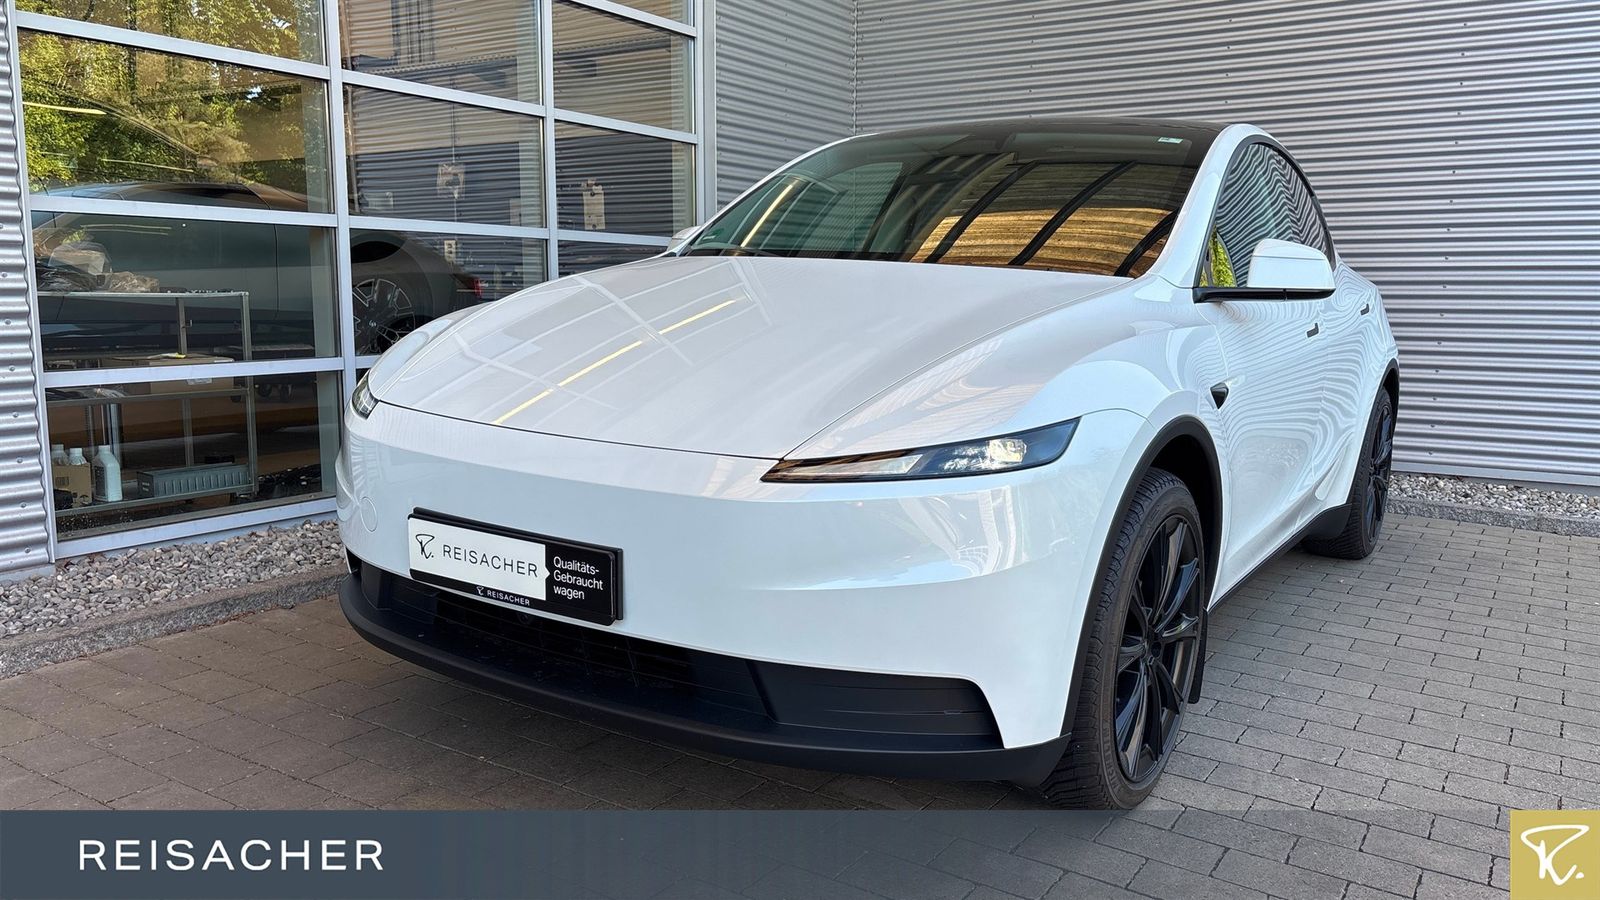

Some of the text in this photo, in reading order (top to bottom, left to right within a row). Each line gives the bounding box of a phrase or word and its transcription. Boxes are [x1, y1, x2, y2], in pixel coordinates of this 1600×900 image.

[442, 544, 538, 578] REISACHER
[553, 556, 600, 575] Qualitäts-
[553, 569, 604, 591] Gebraucht
[486, 589, 530, 606] REISACHER
[553, 585, 585, 600] wagen
